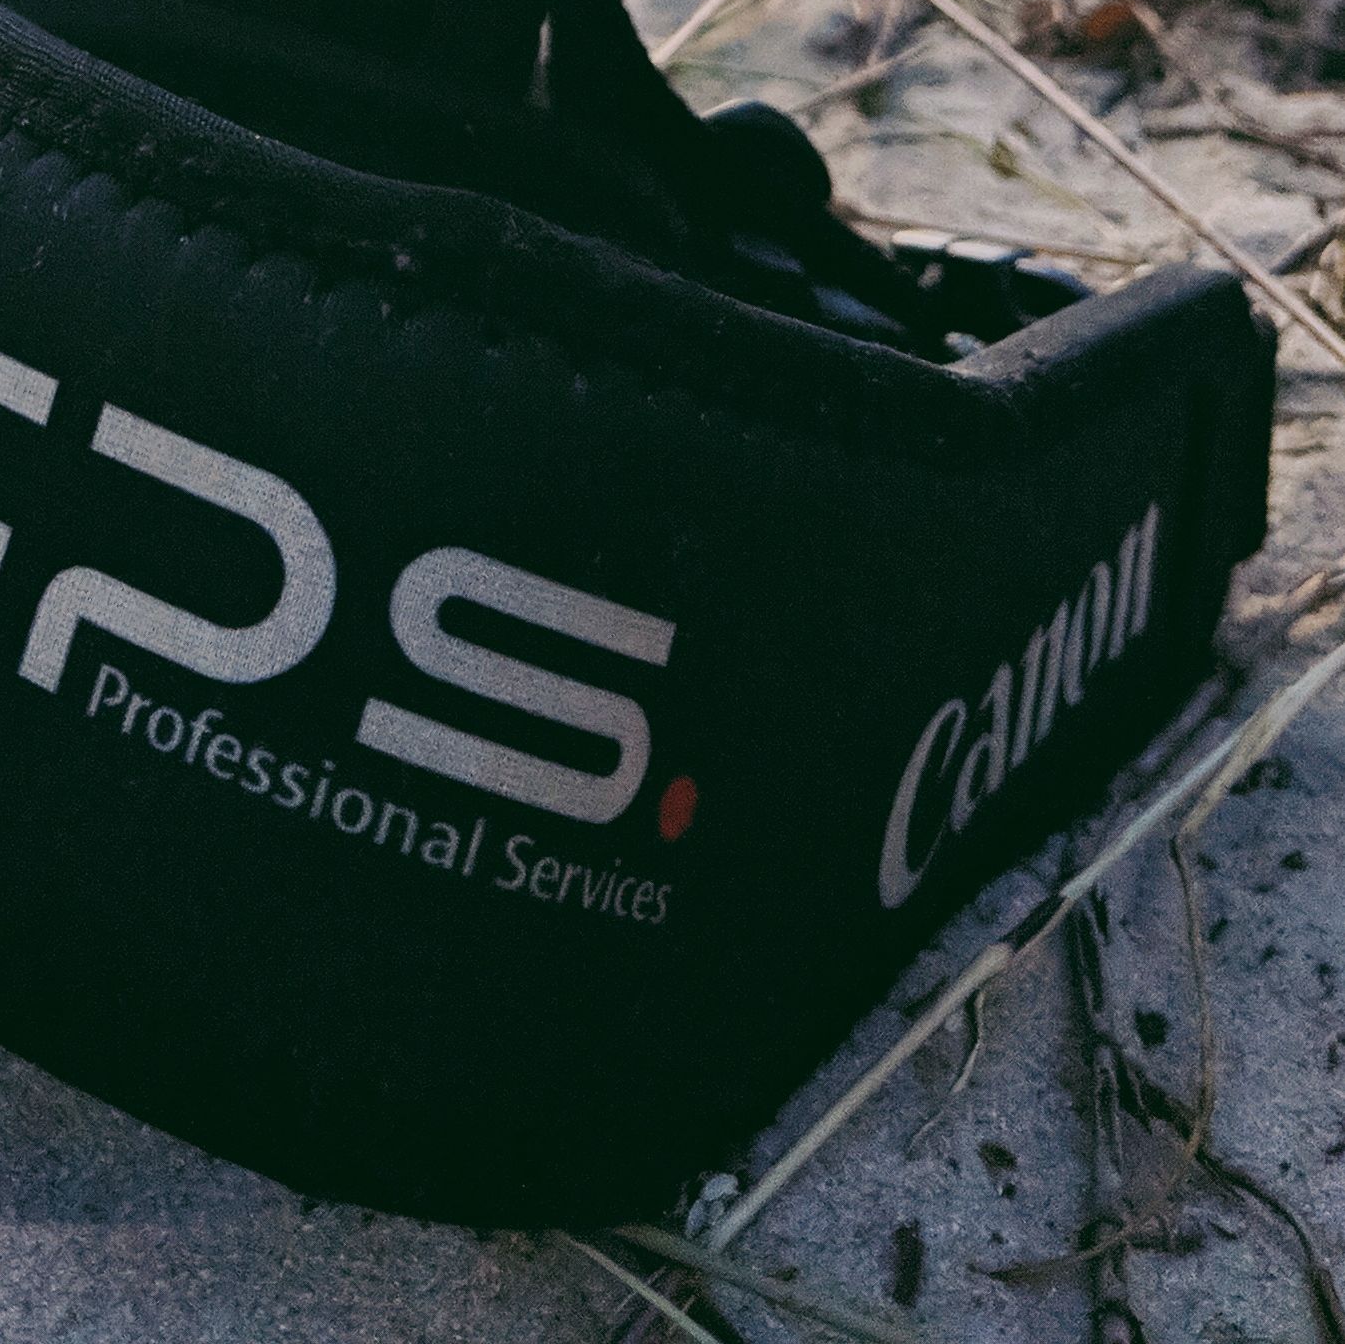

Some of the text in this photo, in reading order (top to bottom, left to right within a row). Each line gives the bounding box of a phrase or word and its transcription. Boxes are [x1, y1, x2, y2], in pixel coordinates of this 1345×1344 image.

[85, 663, 485, 878] Professional
[495, 833, 673, 925] Services
[877, 499, 1159, 910] Canon
